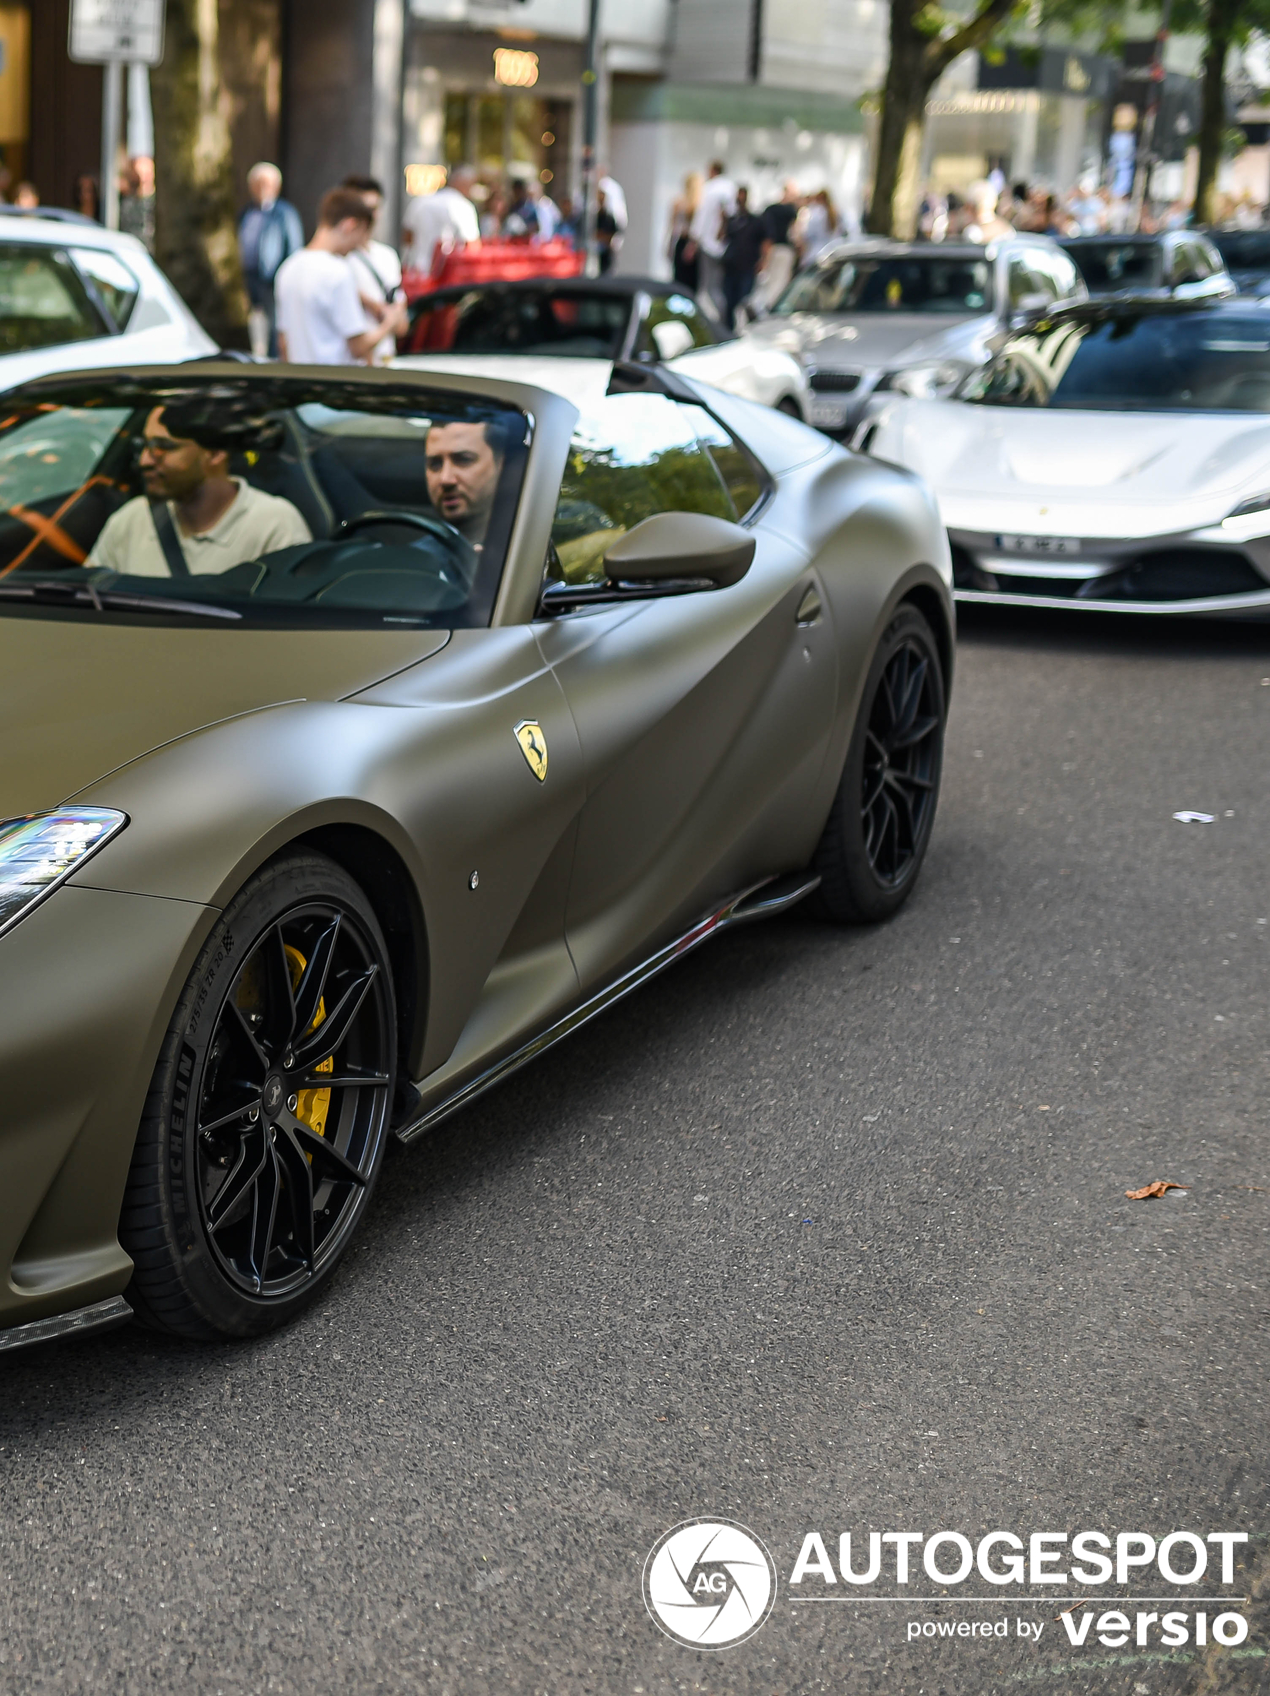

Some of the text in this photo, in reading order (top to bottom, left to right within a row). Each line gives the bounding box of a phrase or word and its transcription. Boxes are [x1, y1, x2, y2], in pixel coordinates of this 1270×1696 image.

[190, 951, 224, 1034] 275/35 ZR 20
[170, 1052, 194, 1214] MICHELIN
